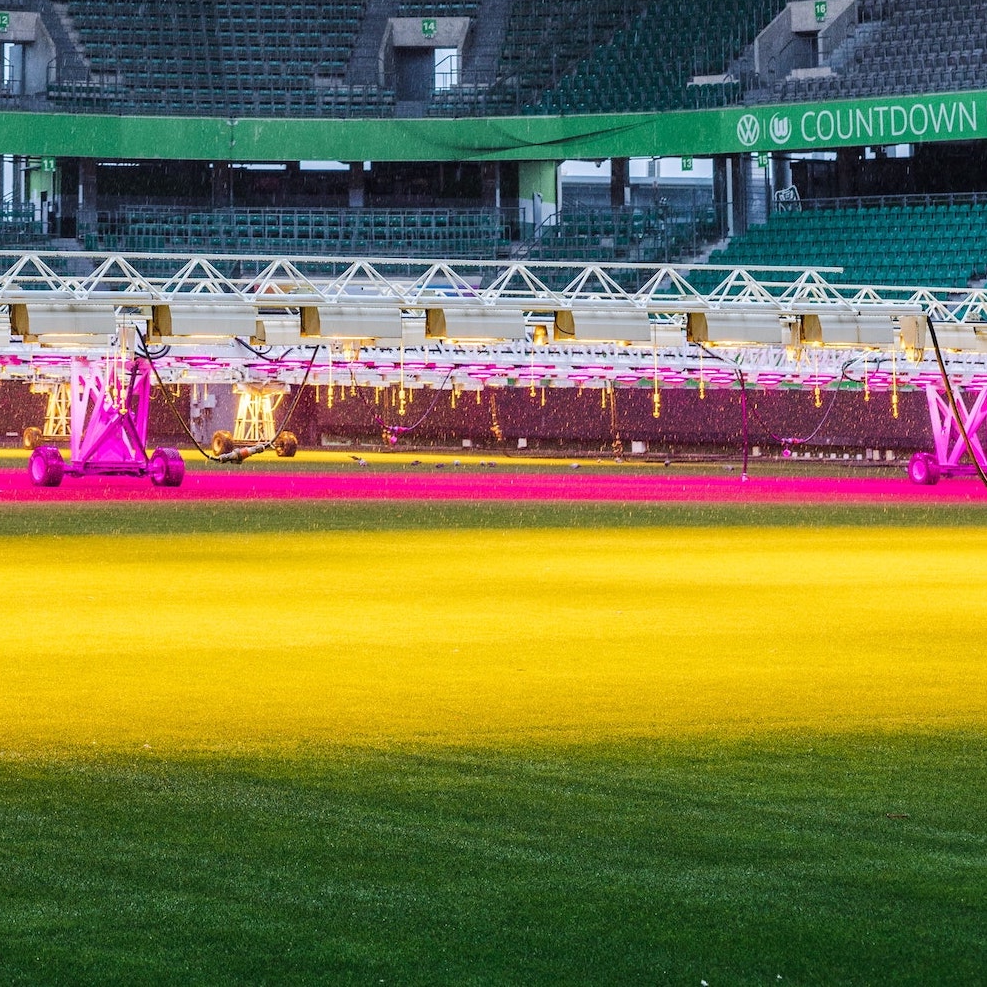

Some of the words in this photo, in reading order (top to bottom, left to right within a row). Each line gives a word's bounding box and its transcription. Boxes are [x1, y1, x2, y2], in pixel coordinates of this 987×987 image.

[815, 4, 826, 14] 16
[424, 22, 435, 31] 14
[801, 100, 978, 143] COUNTDOWN
[42, 159, 54, 169] 11
[682, 158, 693, 168] 13
